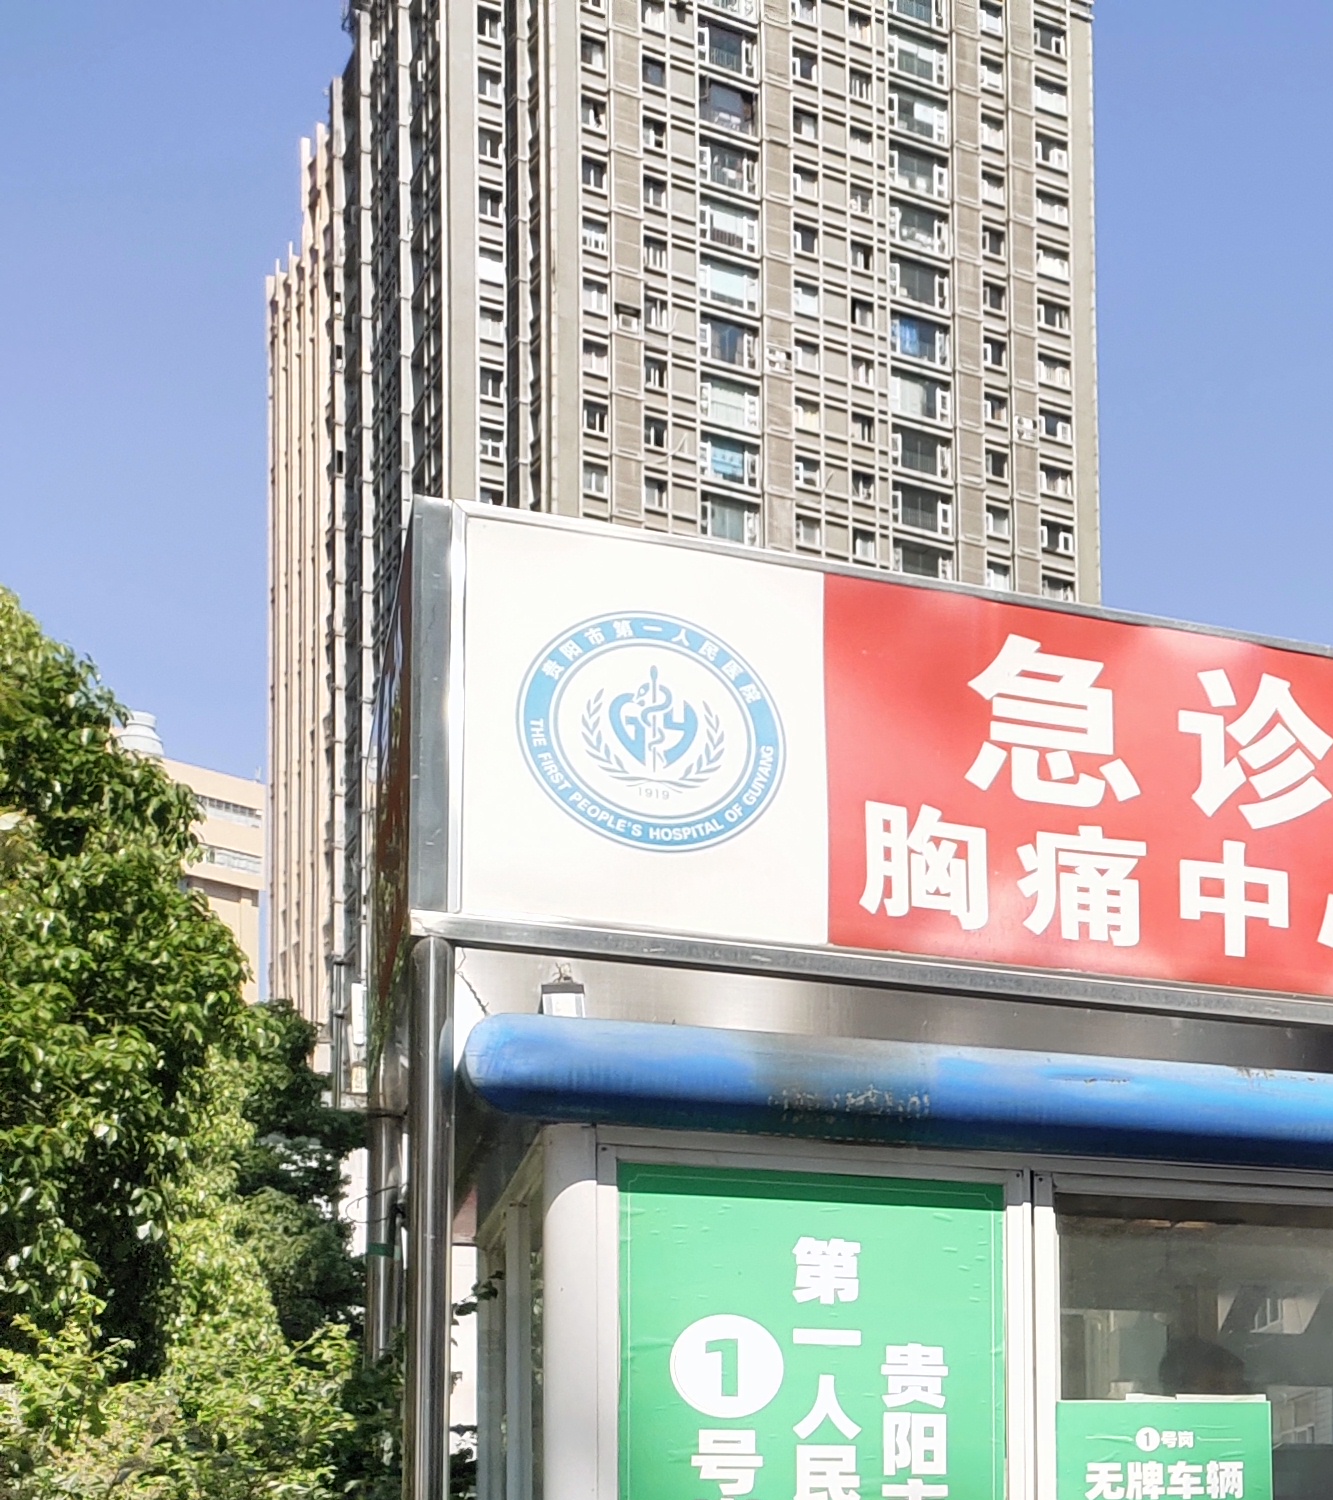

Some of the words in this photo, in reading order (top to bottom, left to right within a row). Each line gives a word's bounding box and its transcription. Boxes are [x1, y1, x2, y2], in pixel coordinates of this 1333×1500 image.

[541, 618, 761, 704] 贵阳市第一人民医院
[530, 718, 545, 747] THE
[537, 751, 572, 792] FIRST
[742, 745, 775, 804] GUIYANG
[638, 786, 670, 800] 1919
[569, 793, 643, 838] PEOPLE'S
[648, 818, 725, 841] HOSPITAL
[724, 804, 744, 823] OF
[1085, 1460, 1245, 1500] 无牌车辆
